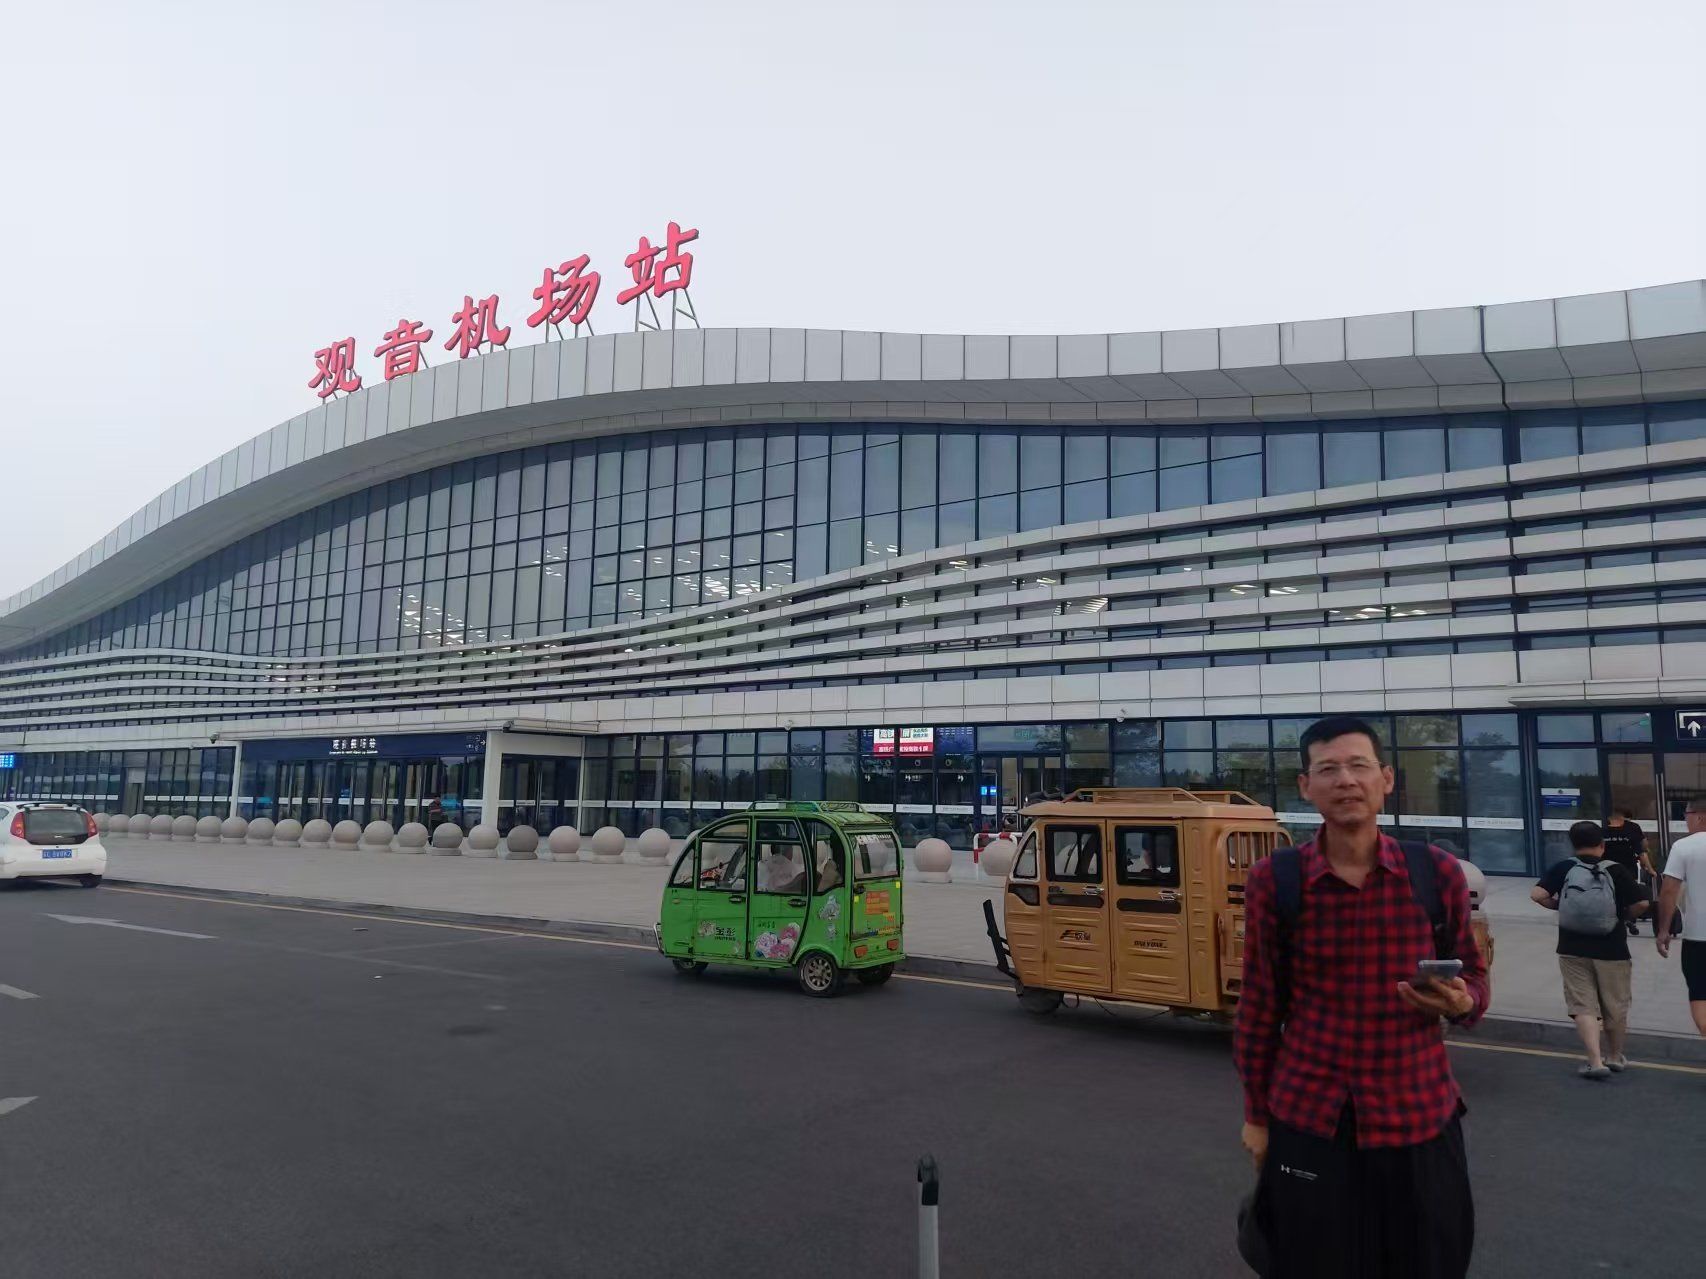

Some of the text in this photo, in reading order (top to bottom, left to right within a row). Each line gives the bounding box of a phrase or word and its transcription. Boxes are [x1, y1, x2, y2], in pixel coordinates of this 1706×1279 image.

[308, 222, 699, 398] 观音机场站
